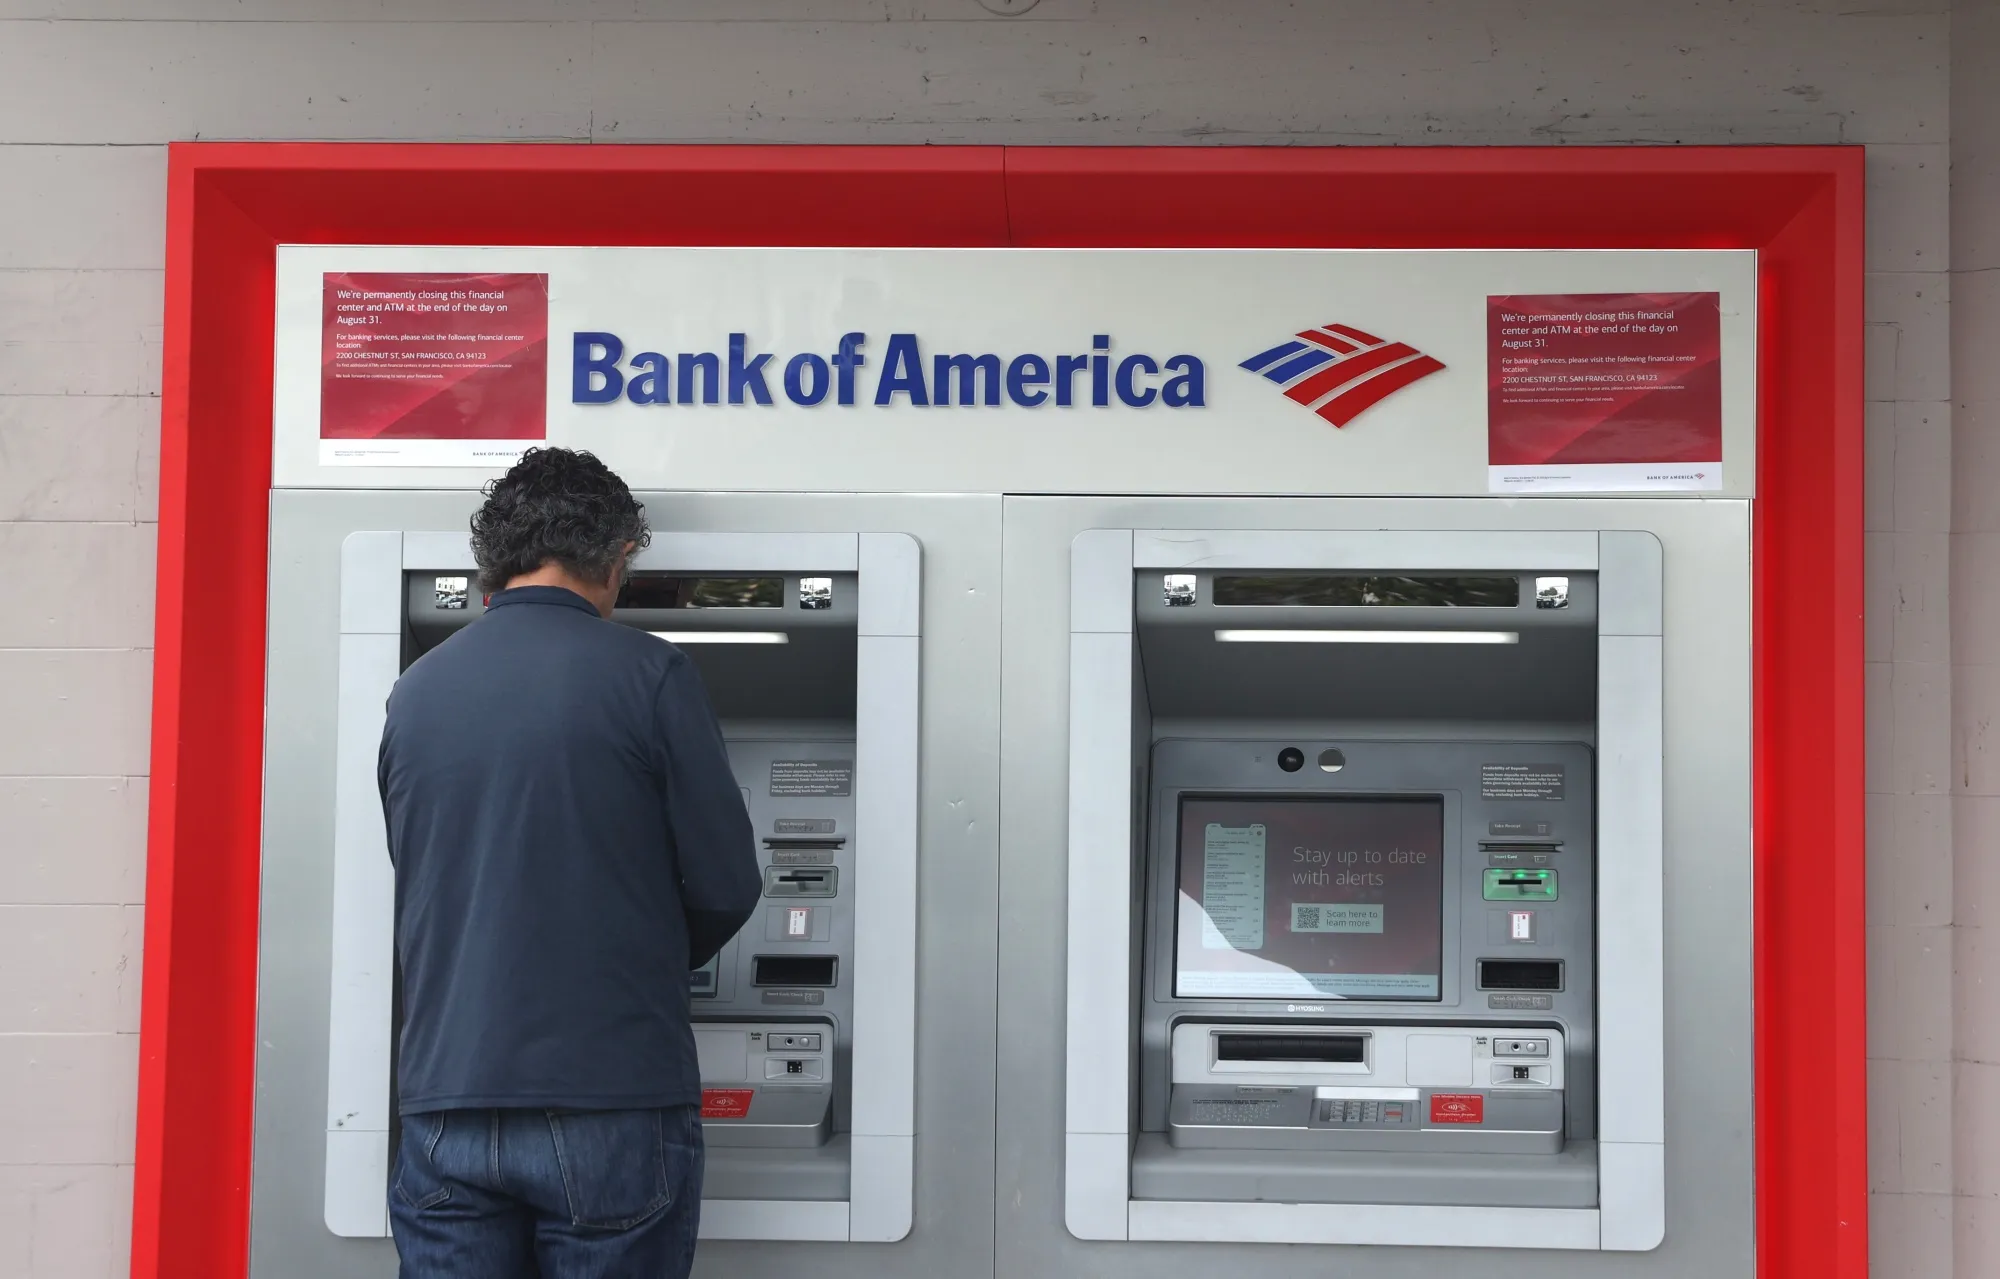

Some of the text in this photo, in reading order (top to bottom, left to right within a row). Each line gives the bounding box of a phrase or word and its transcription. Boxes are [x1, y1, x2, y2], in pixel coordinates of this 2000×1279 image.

[336, 289, 504, 301] We're permanently closing this financial
[336, 303, 364, 311] center
[366, 302, 382, 311] and
[384, 302, 404, 311] ATM
[417, 302, 432, 311] the
[433, 302, 450, 311] end
[451, 302, 461, 311] of
[462, 303, 477, 311] the
[479, 303, 494, 313] day
[336, 315, 382, 326] August 31.
[1500, 310, 1674, 323] We're permanently closing this financial
[1531, 325, 1548, 334] and
[1549, 325, 1570, 334] ATM
[1584, 324, 1599, 333] the
[1601, 324, 1617, 333] end
[1619, 323, 1629, 332] of
[1631, 323, 1646, 332] the
[1648, 323, 1664, 334] day
[347, 333, 372, 341] banking
[447, 333, 476, 342] following
[1501, 338, 1548, 350] August 31.
[1617, 355, 1646, 363] following
[572, 332, 1206, 408] Bank of America
[1293, 846, 1426, 868] Stay up to date
[1292, 869, 1384, 886] with alerts
[1326, 910, 1378, 918] Scan here to
[1326, 919, 1347, 927] learn
